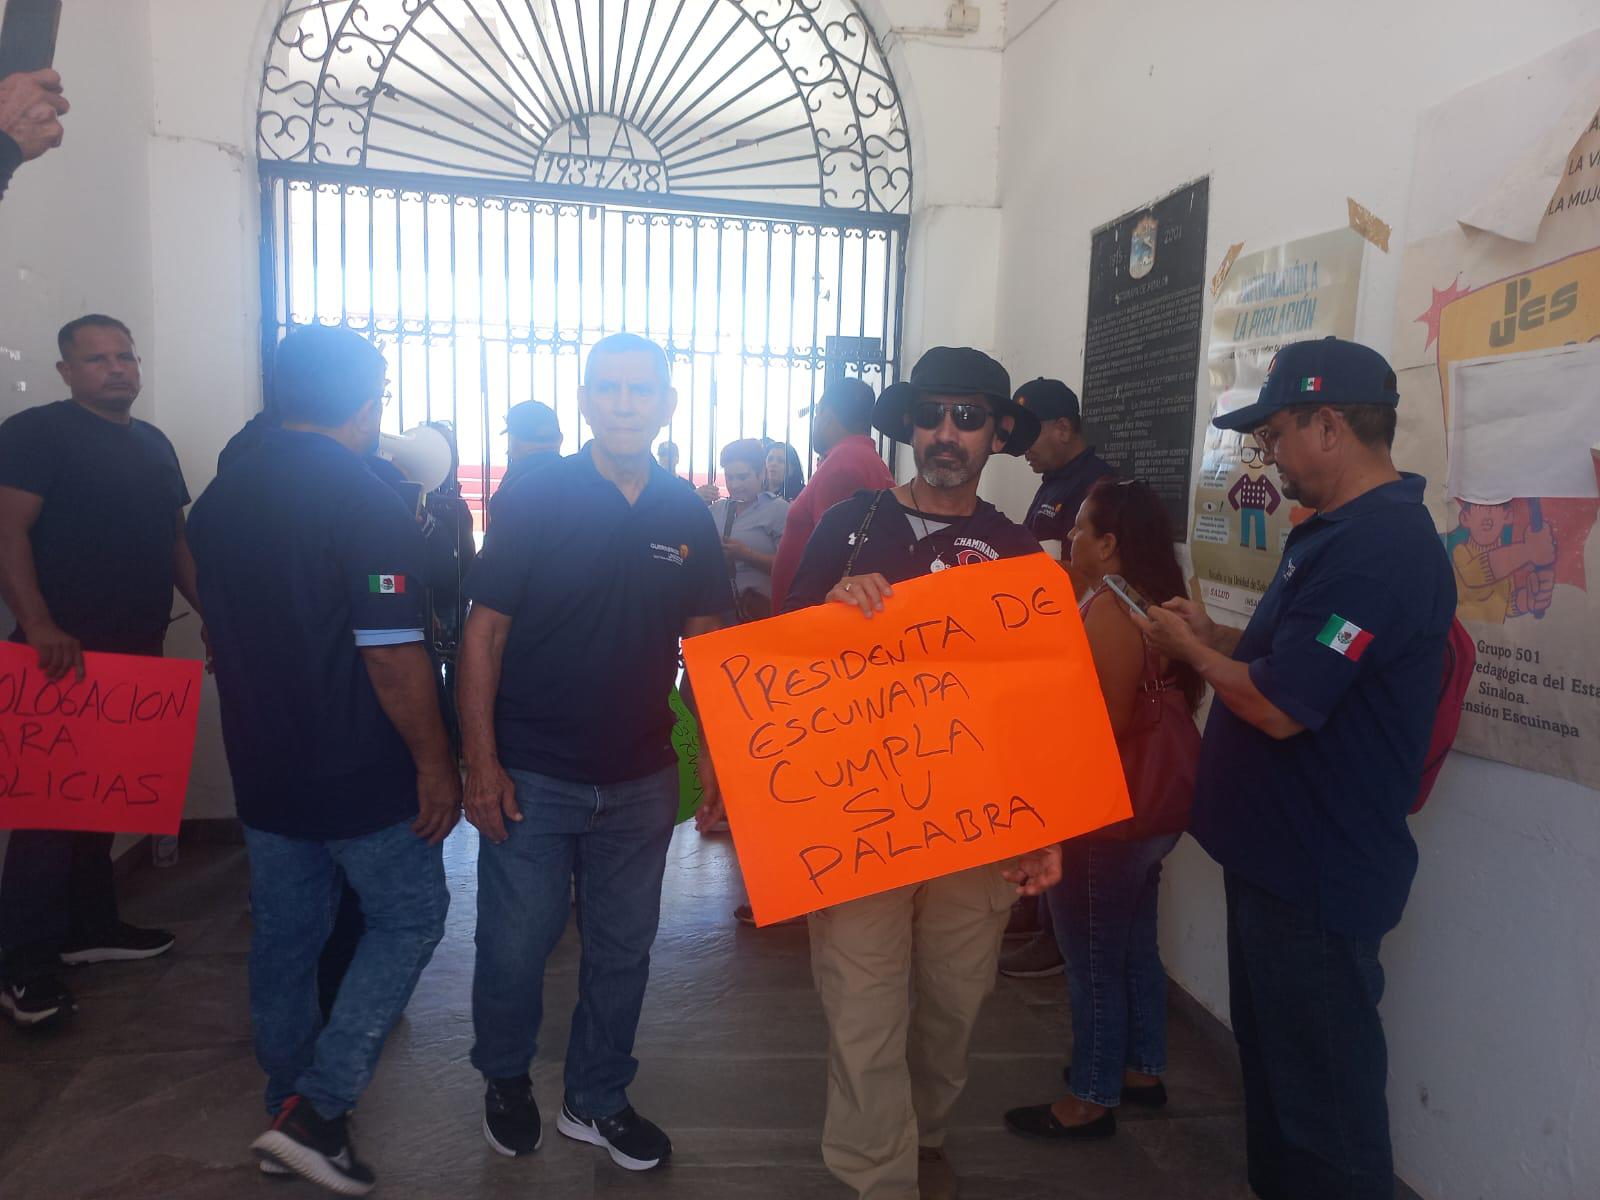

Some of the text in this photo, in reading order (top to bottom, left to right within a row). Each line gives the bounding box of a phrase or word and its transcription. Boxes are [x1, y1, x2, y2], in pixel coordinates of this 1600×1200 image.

[541, 151, 661, 193] 1937/38
[1568, 154, 1583, 177] LA
[1311, 259, 1319, 293] A
[1232, 311, 1250, 342] LA
[1249, 293, 1318, 341] POBLACIÓN
[953, 537, 1000, 561] CHAMINADE
[1209, 587, 1231, 600] SALUD
[721, 586, 1062, 720] PRESIDENTA DE
[1477, 639, 1541, 665] Grupo 501
[1473, 660, 1538, 685] edagógica
[1542, 673, 1565, 691] del
[1478, 680, 1530, 705] Sinaloa.
[748, 671, 970, 759] ESCUINAPA
[1501, 706, 1580, 738] Escuinapa
[768, 718, 985, 804] CUMPLA
[842, 770, 932, 833] SU
[799, 795, 1046, 895] PALABRA
